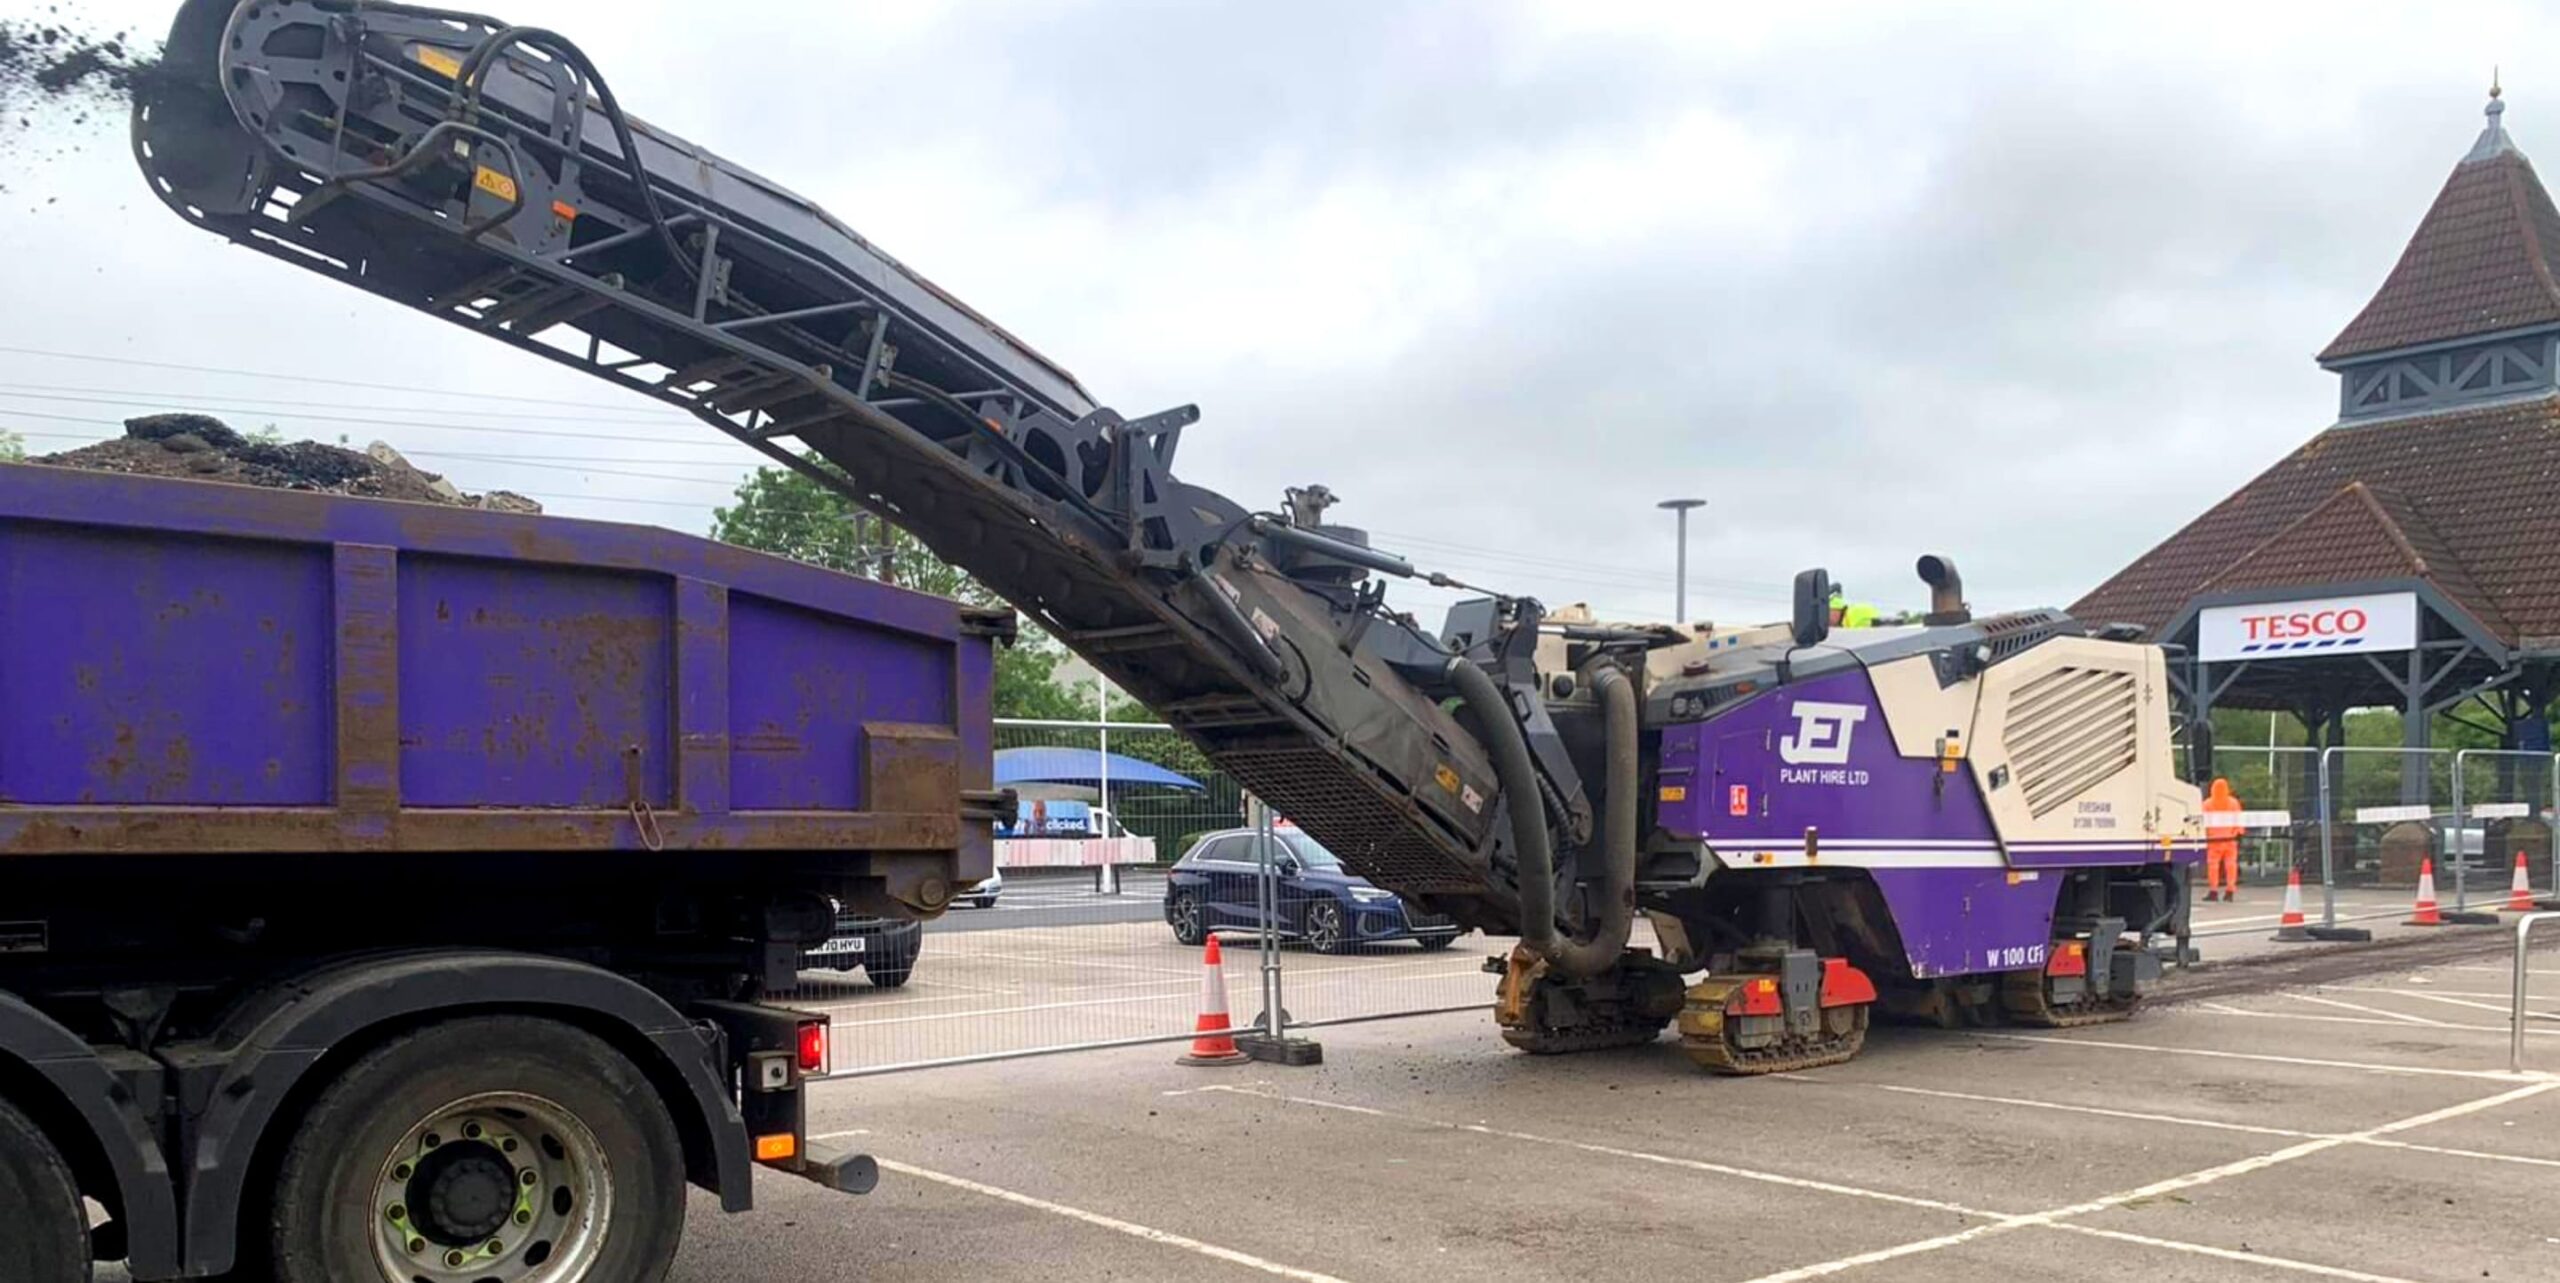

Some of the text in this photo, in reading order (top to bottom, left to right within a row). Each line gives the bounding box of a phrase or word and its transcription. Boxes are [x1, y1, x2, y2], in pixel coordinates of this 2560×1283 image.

[2241, 609, 2366, 640] TESCO
[1780, 701, 1867, 764] JET
[1780, 768, 1869, 785] PLANT HIRE LTD
[1046, 817, 1087, 831] clicked.
[840, 940, 861, 950] HYU
[1986, 944, 2044, 968] W 100 CFi
